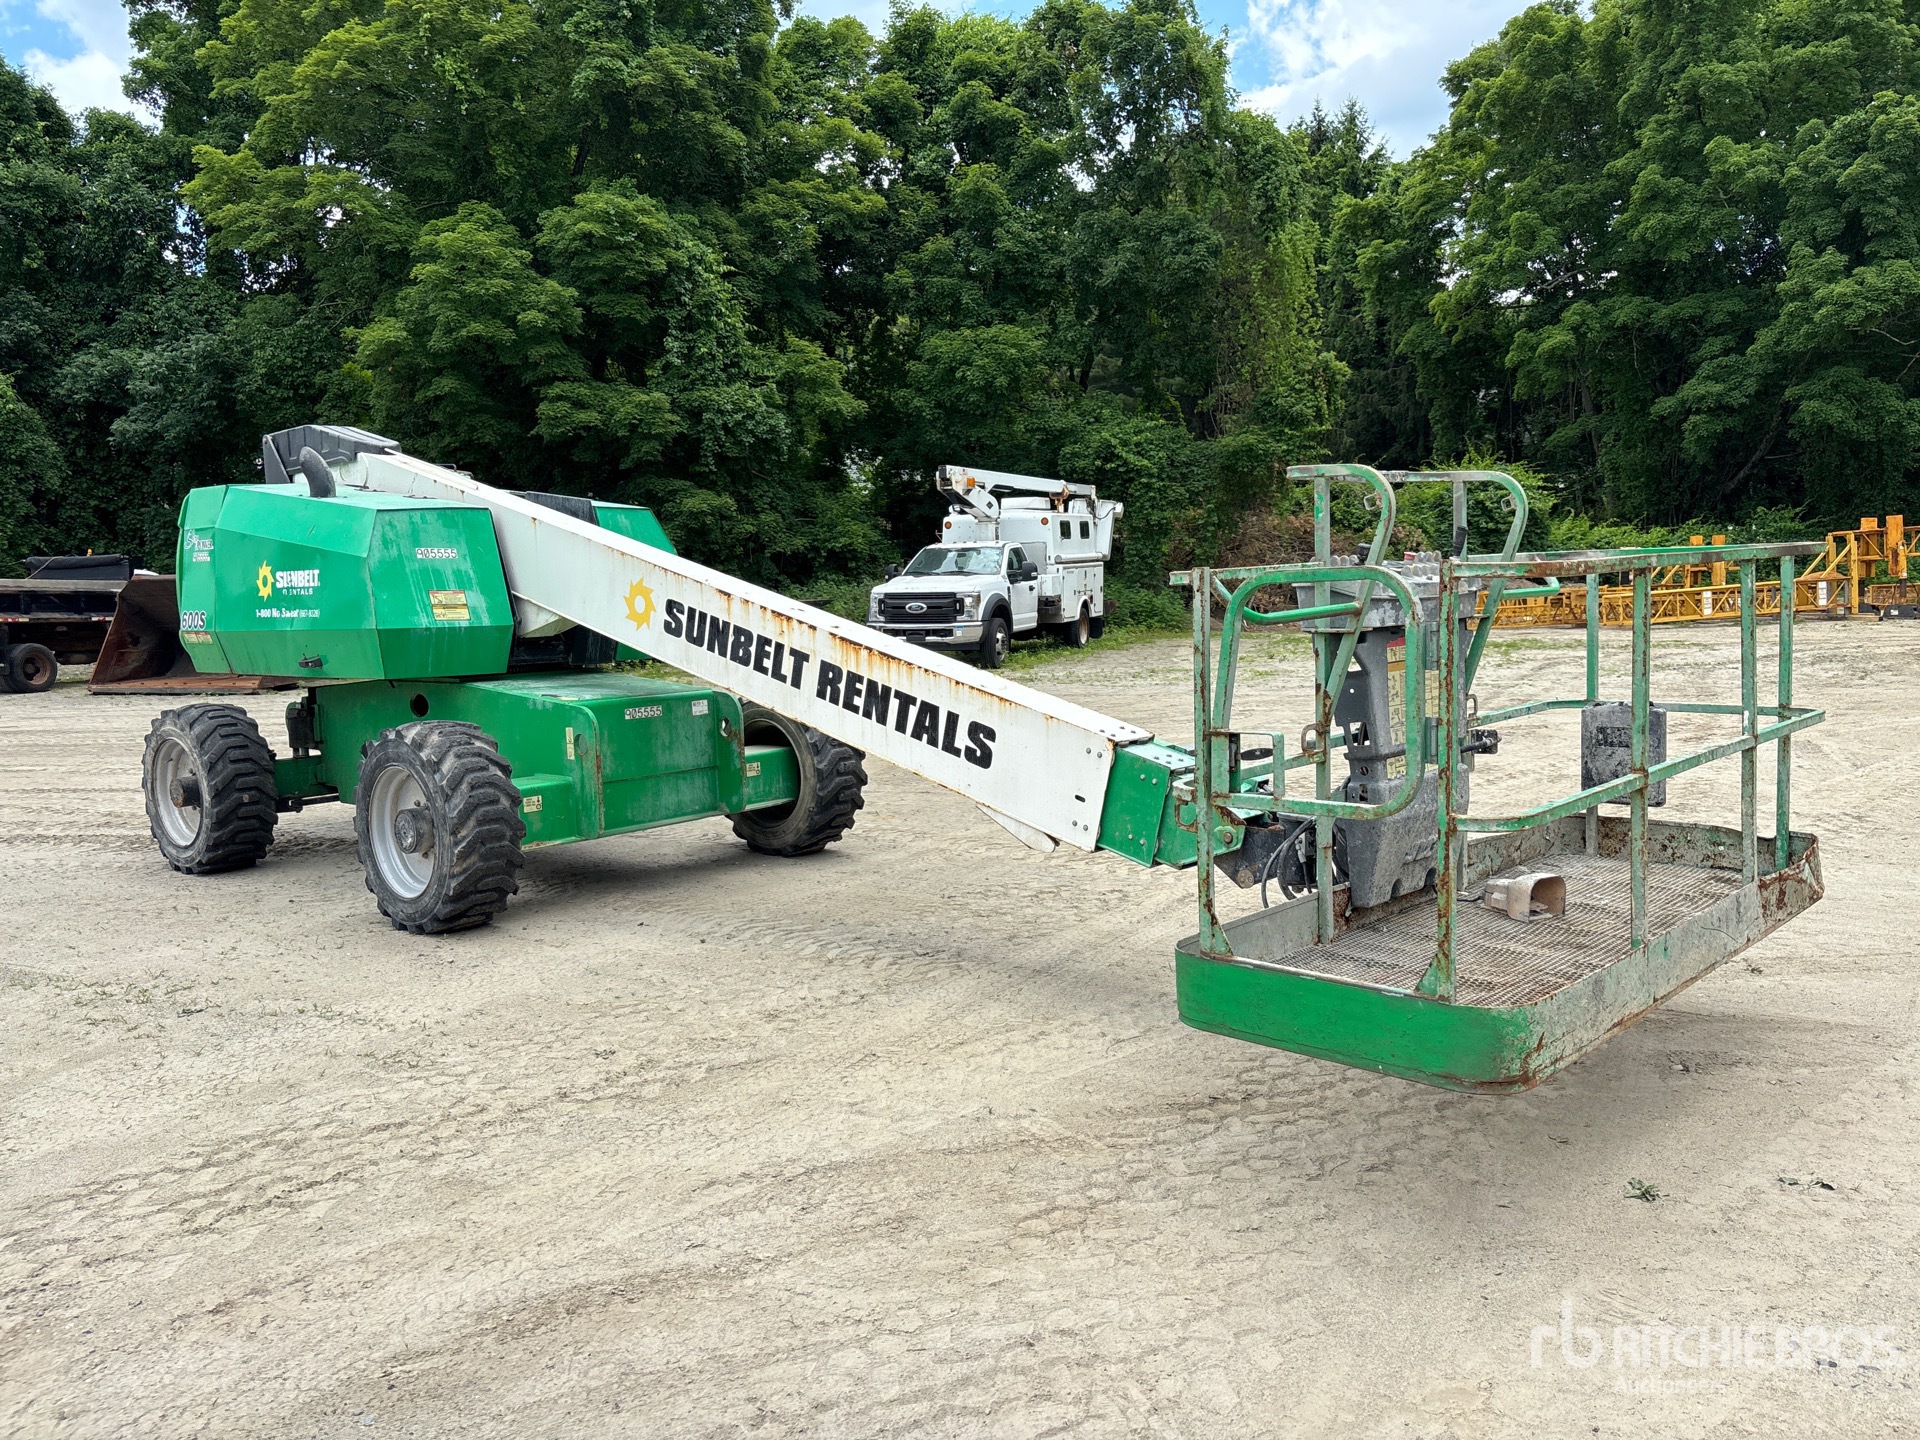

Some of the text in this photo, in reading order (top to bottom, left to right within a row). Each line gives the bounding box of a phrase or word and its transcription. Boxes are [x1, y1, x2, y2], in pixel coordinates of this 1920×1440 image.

[417, 549, 457, 558] 905555
[276, 569, 319, 588] SUNBELT
[182, 611, 206, 630] 600S
[256, 609, 271, 618] 1-800
[272, 608, 281, 618] No
[663, 598, 997, 770] SUNBELT RENTALS
[625, 707, 661, 718] 905555
